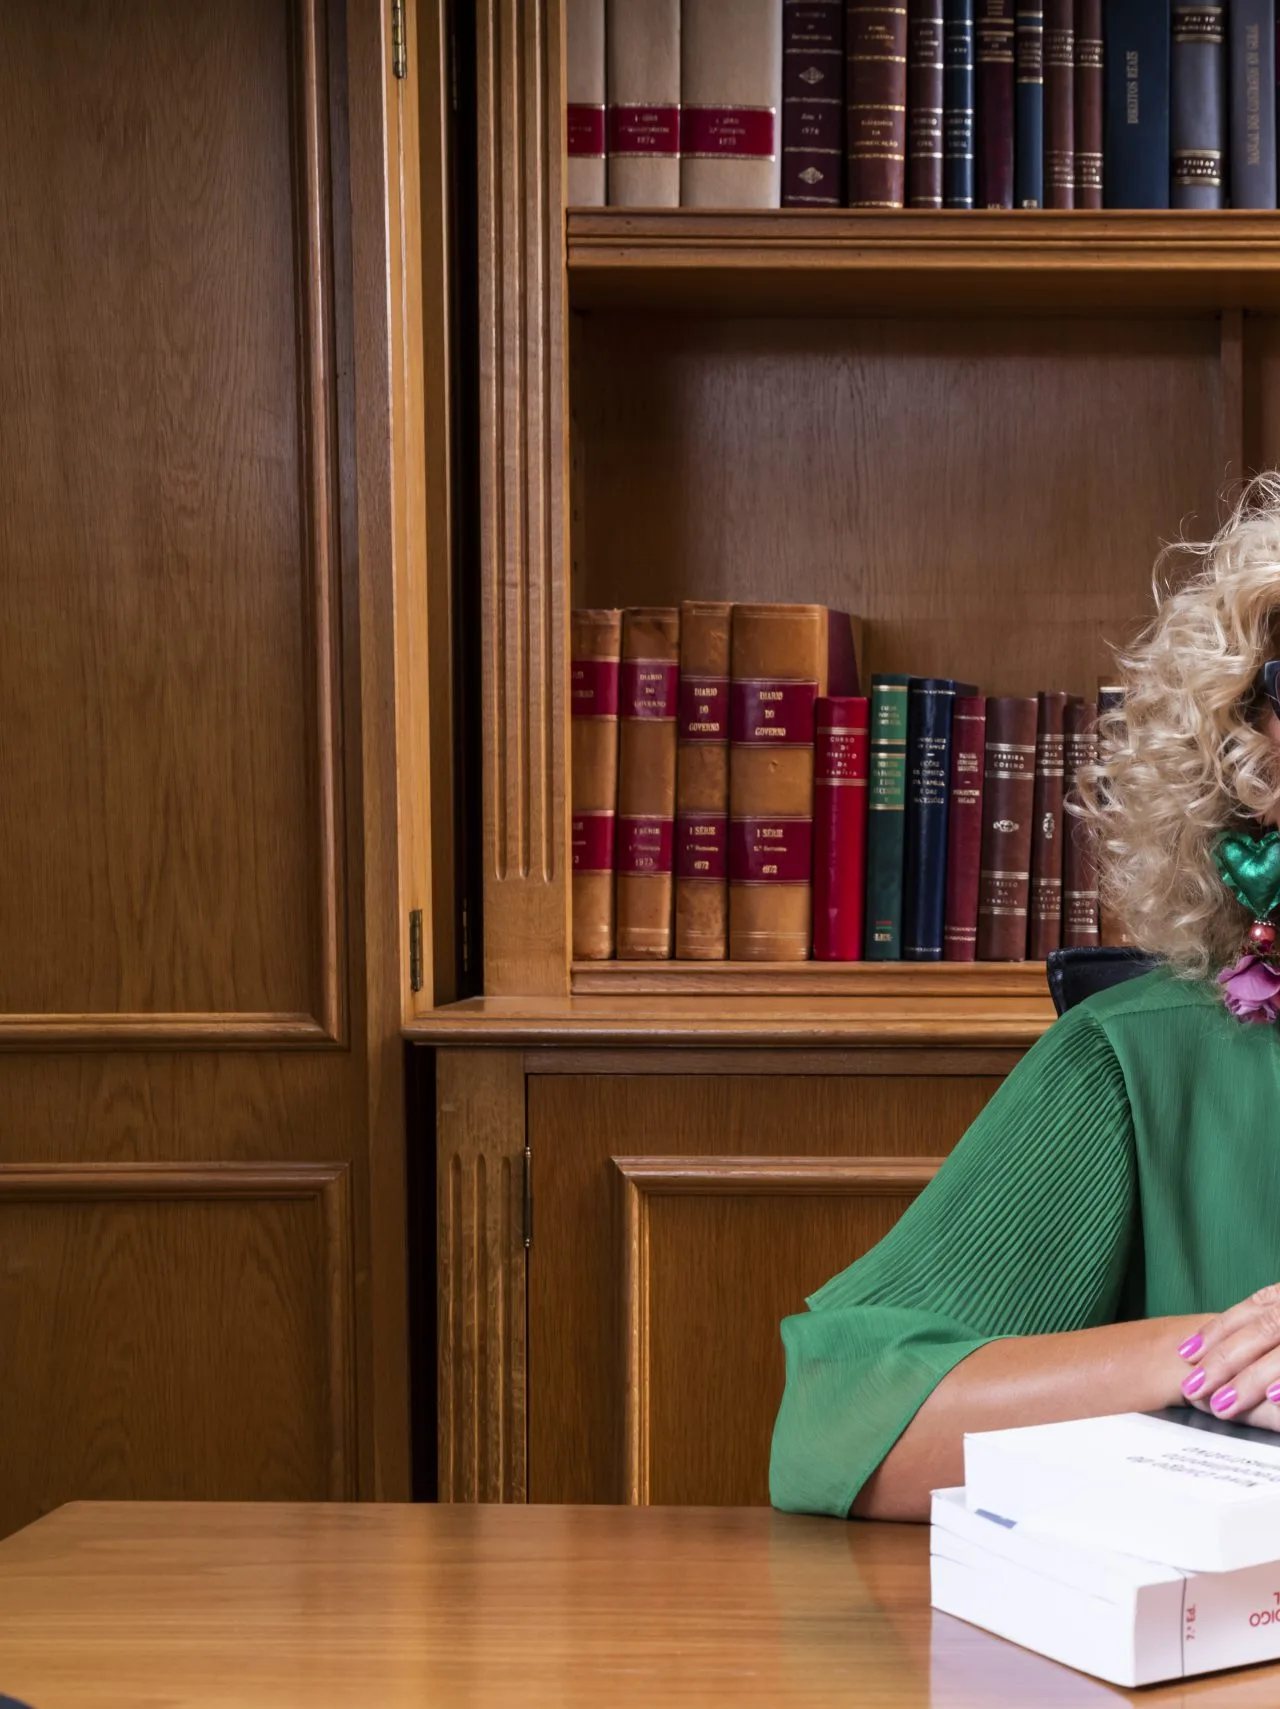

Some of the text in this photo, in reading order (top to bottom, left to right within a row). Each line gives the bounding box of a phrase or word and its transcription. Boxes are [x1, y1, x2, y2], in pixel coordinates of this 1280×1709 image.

[688, 722, 720, 732] GOVERNO
[755, 727, 787, 737] GOVERNO
[1186, 1604, 1196, 1623] Ed.
